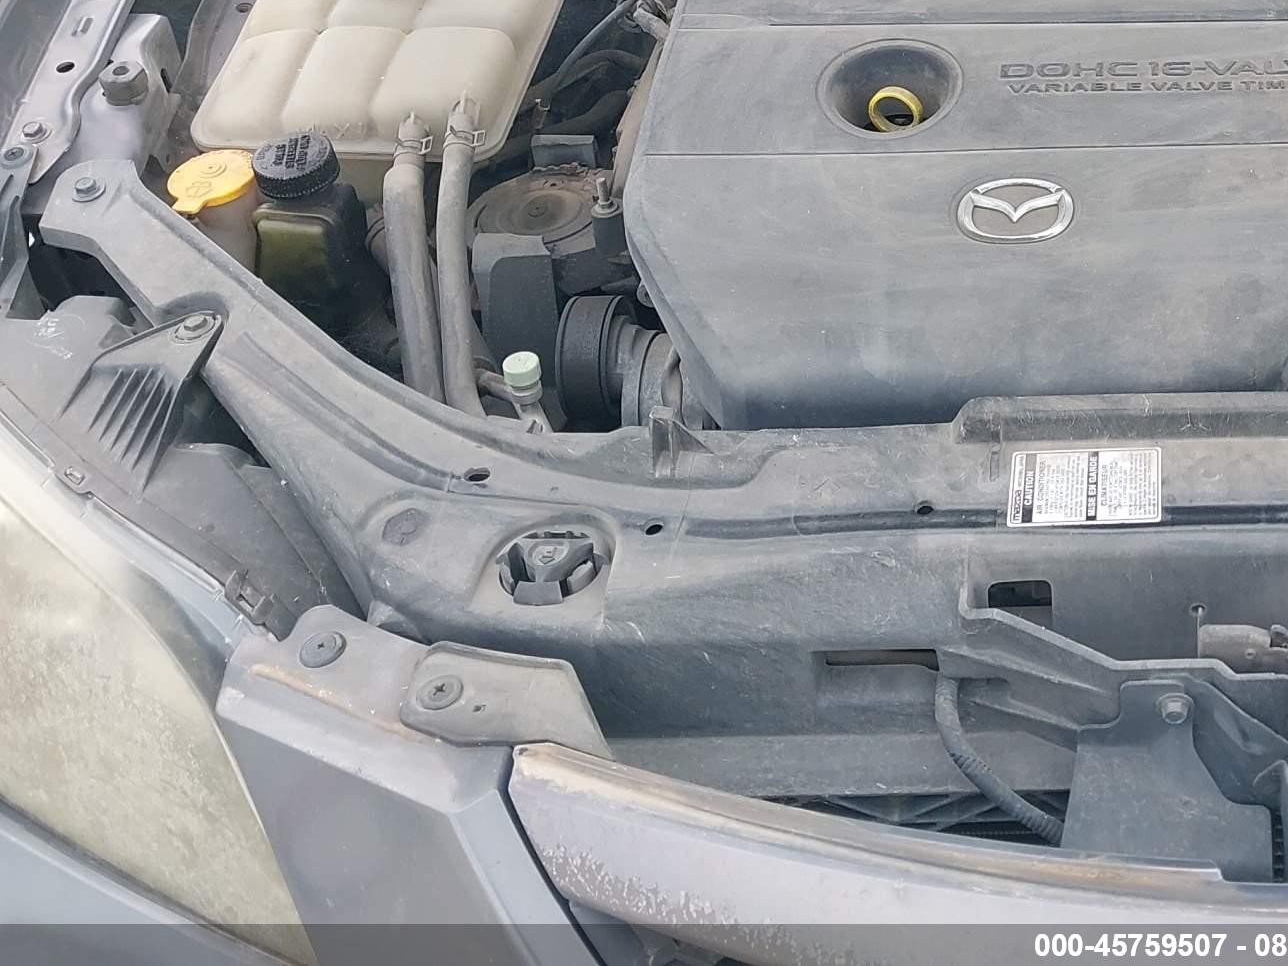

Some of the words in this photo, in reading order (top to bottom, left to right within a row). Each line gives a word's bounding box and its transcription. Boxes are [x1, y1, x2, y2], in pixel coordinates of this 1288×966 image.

[999, 62, 1139, 79] DOHC
[1007, 80, 1142, 94] VARIABLE
[1150, 79, 1233, 93] VALVE
[1088, 455, 1098, 483] GARDE
[1024, 470, 1035, 506] CAUTION
[1088, 483, 1097, 495] EN
[1013, 489, 1022, 521] mazda
[1088, 496, 1097, 517] MISE
